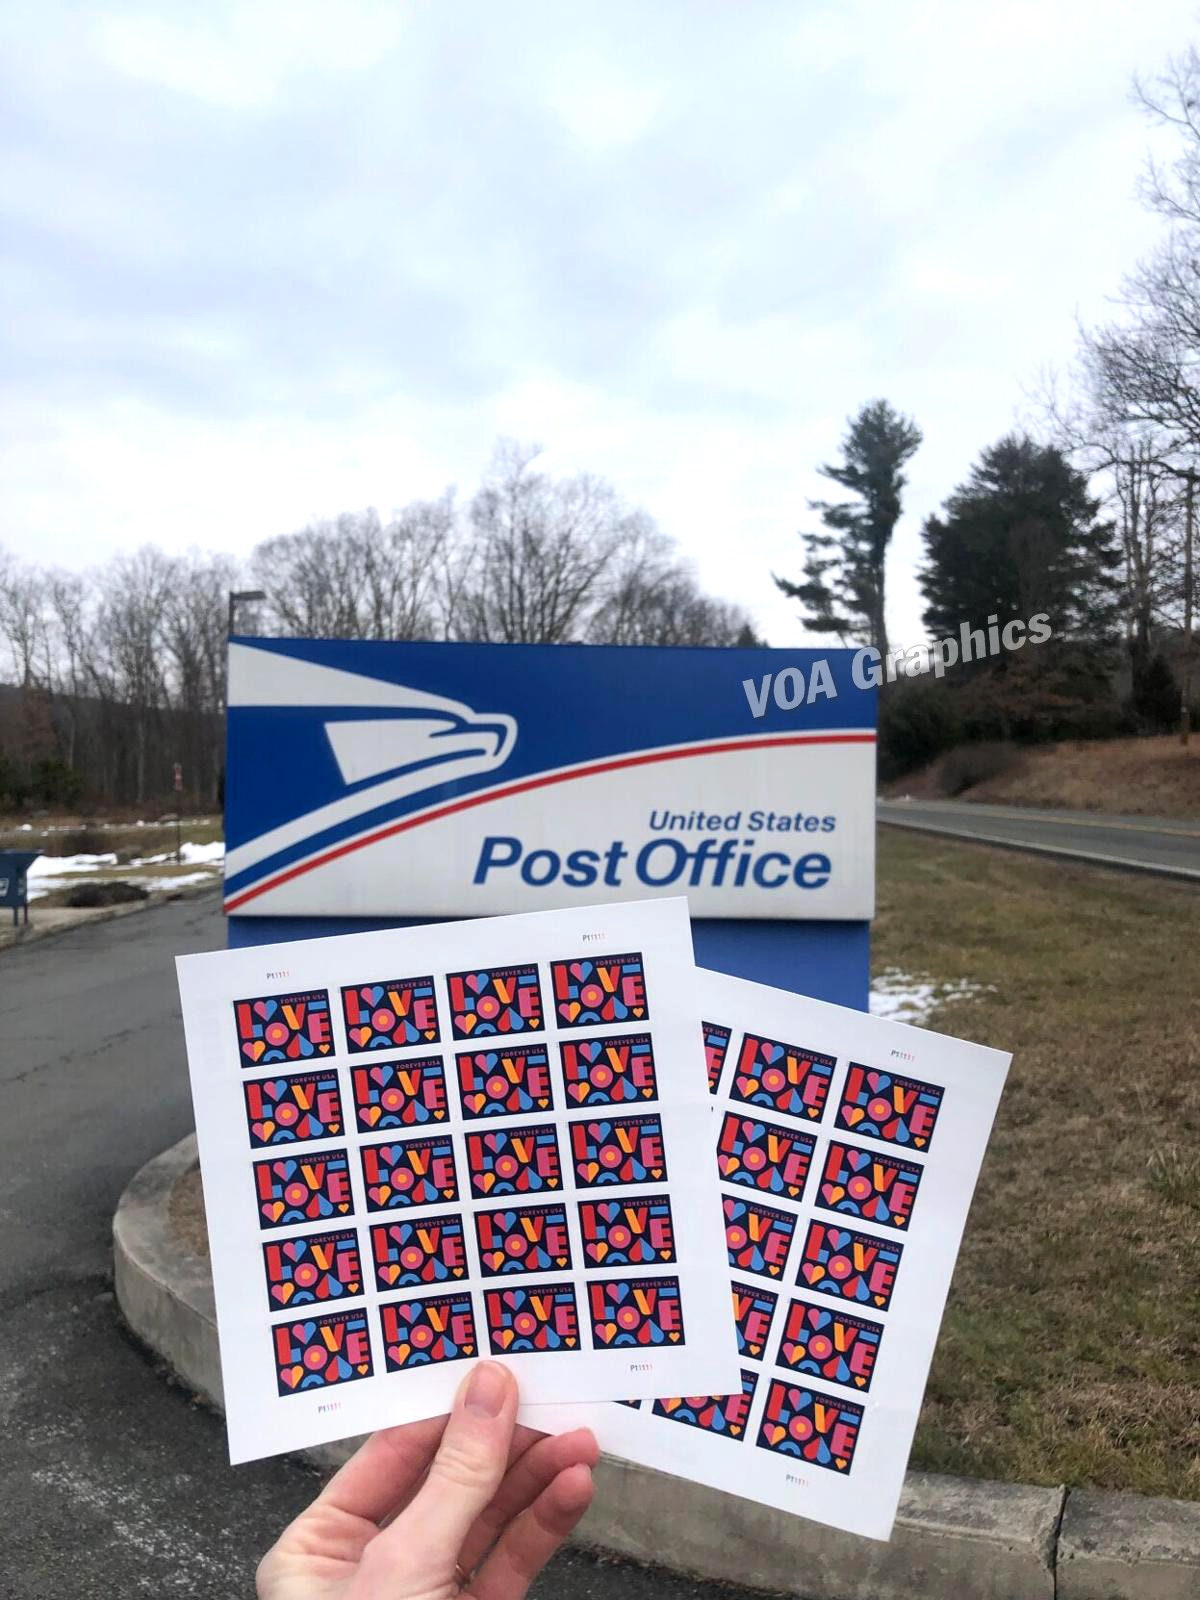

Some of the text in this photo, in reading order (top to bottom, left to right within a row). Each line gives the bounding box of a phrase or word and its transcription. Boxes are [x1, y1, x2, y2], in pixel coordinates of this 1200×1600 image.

[649, 810, 836, 832] United States
[473, 836, 832, 890] Post Office
[491, 969, 520, 977] FOREVER
[596, 957, 624, 965] FOREVER
[281, 995, 311, 1004] FOREVER
[387, 982, 416, 990] FOREVER
[450, 975, 541, 1019] LOVE
[555, 964, 645, 1007] LOVE
[237, 1001, 331, 1046] LOVE
[344, 988, 437, 1032] LOVE
[501, 1048, 530, 1057] FOREVER
[603, 1038, 633, 1046] FOREVER
[788, 1048, 833, 1065] FOREVER USA
[291, 1075, 320, 1084] FOREVER
[396, 1061, 426, 1069] FOREVER
[459, 1055, 550, 1099] LOVE
[563, 1044, 654, 1088] LOVE
[739, 1039, 832, 1108] LOVE
[247, 1081, 341, 1126] LOVE
[355, 1067, 446, 1111] LOVE
[844, 1067, 939, 1137] LOVE
[894, 1078, 940, 1095] FOREVER USA
[510, 1129, 539, 1137] FOREVER
[614, 1118, 643, 1126] FOREVER
[767, 1126, 812, 1143] FOREVER USA
[299, 1154, 329, 1163] FOREVER
[405, 1140, 434, 1148] FOREVER
[468, 1135, 559, 1179] LOVE
[572, 1125, 664, 1169] LOVE
[718, 1116, 811, 1186] LOVE
[875, 1156, 920, 1173] FOREVER USA
[257, 1160, 351, 1206] LOVE
[364, 1146, 456, 1190] LOVE
[825, 1146, 919, 1216] LOVE
[416, 1219, 445, 1227] FOREVER
[519, 1208, 548, 1216] FOREVER
[582, 1205, 673, 1249] LOVE
[748, 1205, 793, 1222] FOREVER USA
[310, 1234, 340, 1244] FOREVER
[374, 1225, 465, 1270] LOVE
[478, 1215, 569, 1257] LOVE
[726, 1211, 792, 1265] OVE
[855, 1235, 900, 1252] FOREVER USA
[266, 1240, 360, 1288] LOVE
[805, 1225, 899, 1296] LOVE
[425, 1297, 454, 1306] FOREVER
[527, 1287, 557, 1295] FOREVER
[591, 1285, 681, 1330] LOVE
[761, 1293, 774, 1302] USA
[319, 1311, 363, 1325] FOREVER USA
[383, 1303, 475, 1349] LOVE
[487, 1293, 577, 1336] LOVE
[835, 1314, 879, 1332] FOREVER USA
[276, 1319, 370, 1370] LOVE
[785, 1304, 878, 1376] LOVE
[766, 1384, 860, 1459] LOVE
[815, 1395, 861, 1414] FOREVER USA
